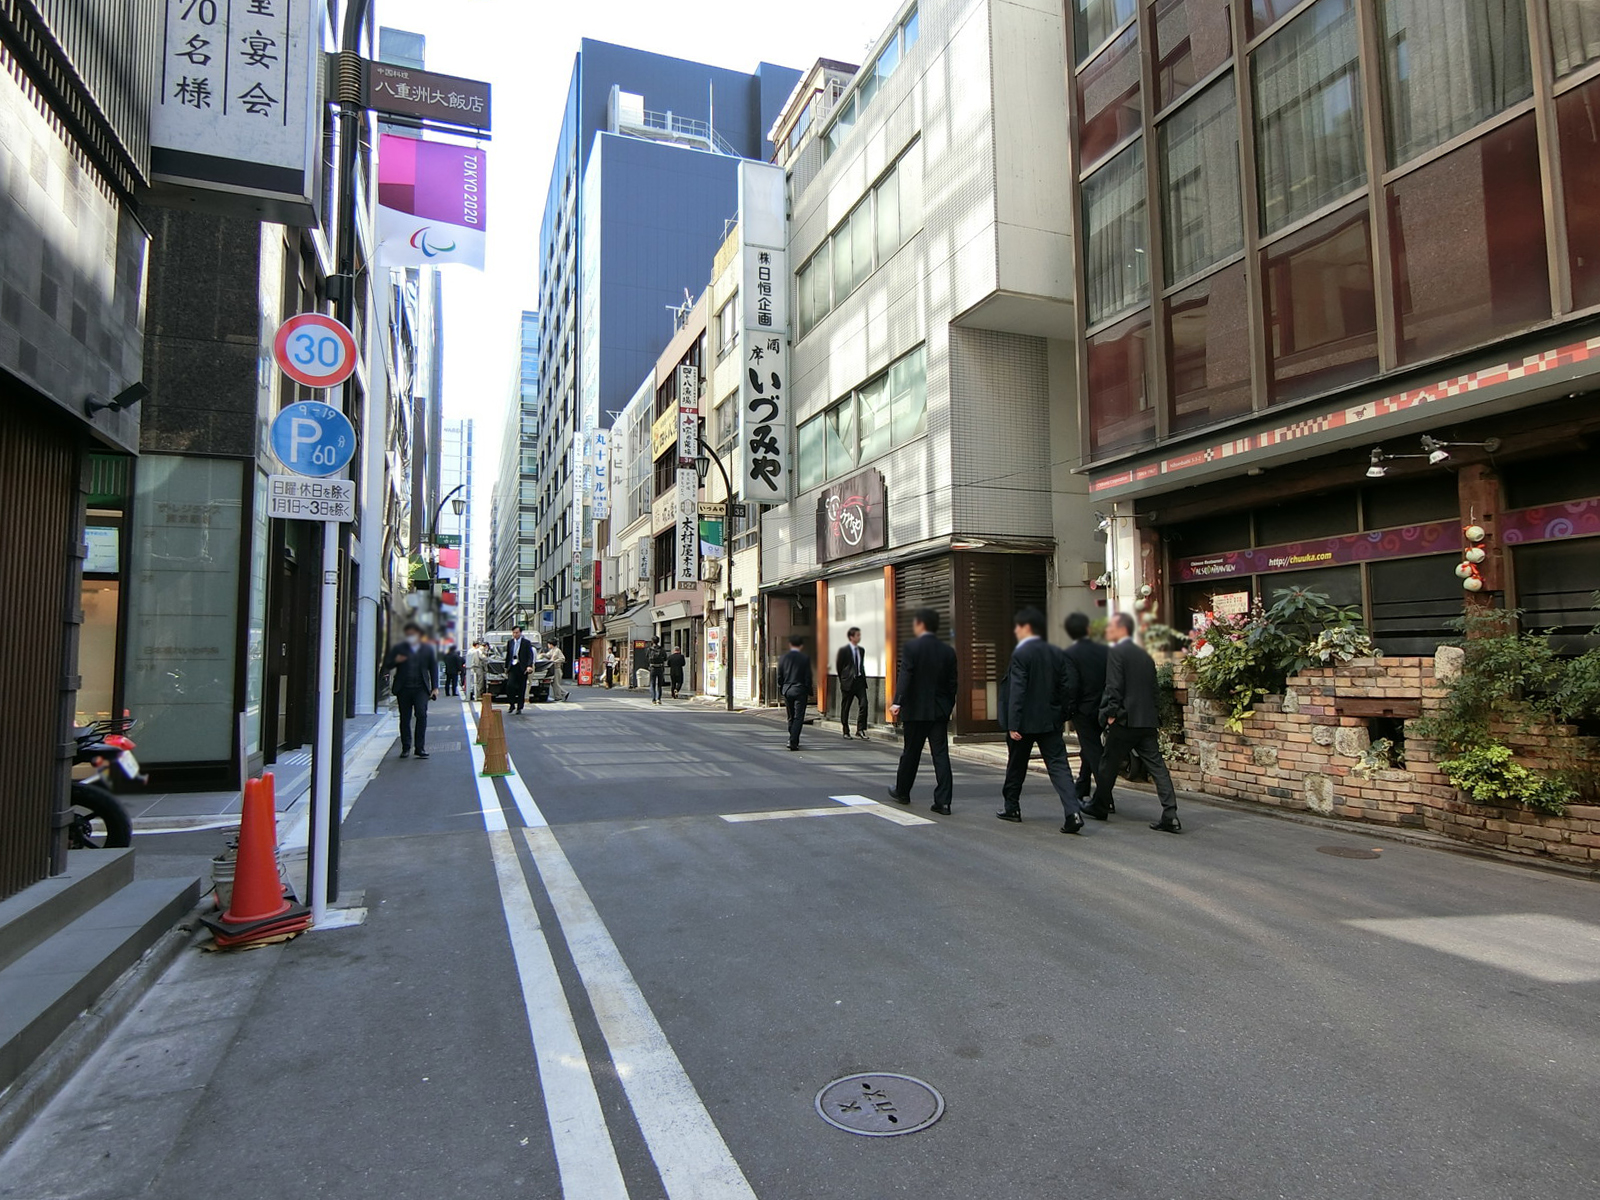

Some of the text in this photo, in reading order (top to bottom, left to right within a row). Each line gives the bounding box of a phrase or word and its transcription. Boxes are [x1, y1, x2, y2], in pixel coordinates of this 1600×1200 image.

[375, 81, 484, 112] 八重洲大飯店
[377, 67, 410, 80] 中国料理
[464, 154, 478, 224] TOKYO 2020
[294, 334, 338, 367] 30
[290, 417, 322, 463] P
[748, 367, 781, 492] いづみや
[595, 433, 606, 493] 丸十ビル
[734, 508, 745, 516] 35
[681, 517, 694, 578] 木村屋本店
